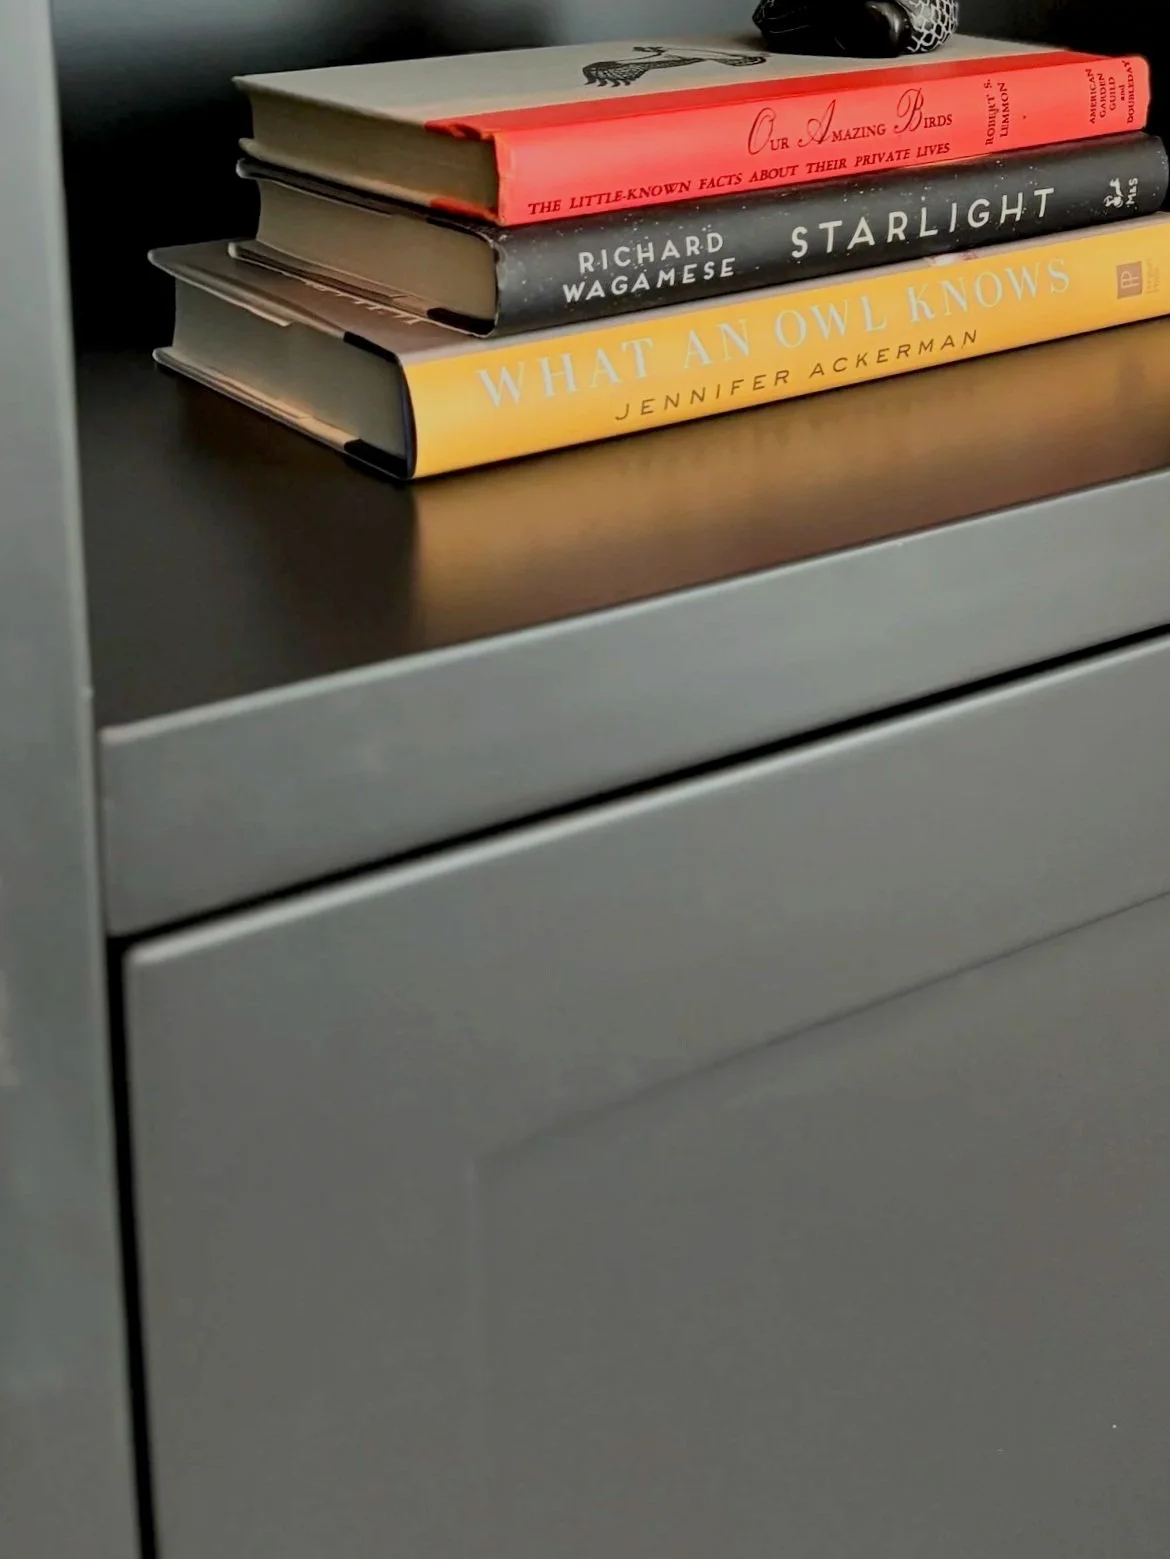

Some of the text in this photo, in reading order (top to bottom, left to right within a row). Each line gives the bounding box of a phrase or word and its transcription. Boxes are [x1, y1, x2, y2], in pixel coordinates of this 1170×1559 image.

[984, 93, 998, 146] ROBERT
[997, 81, 1010, 138] LEMMON
[1085, 68, 1097, 125] AMERICAN
[1097, 72, 1106, 119] GARDEN
[1108, 75, 1116, 112] GUILD
[1121, 59, 1135, 125] DOUBLEDAY
[528, 142, 951, 215] THE LITTLE-KNOWN FACTS ABOUT THEIR PRIVATE LIVES
[791, 187, 1055, 259] STARLIGHT
[562, 257, 736, 304] WAGAMESE
[578, 231, 724, 275] RICHARD
[477, 336, 655, 409] WHAT
[682, 317, 751, 370] AN
[774, 294, 888, 350] OWL
[907, 257, 1071, 324] KNOWS
[615, 329, 978, 421] JENNIFER ACKERMAN
